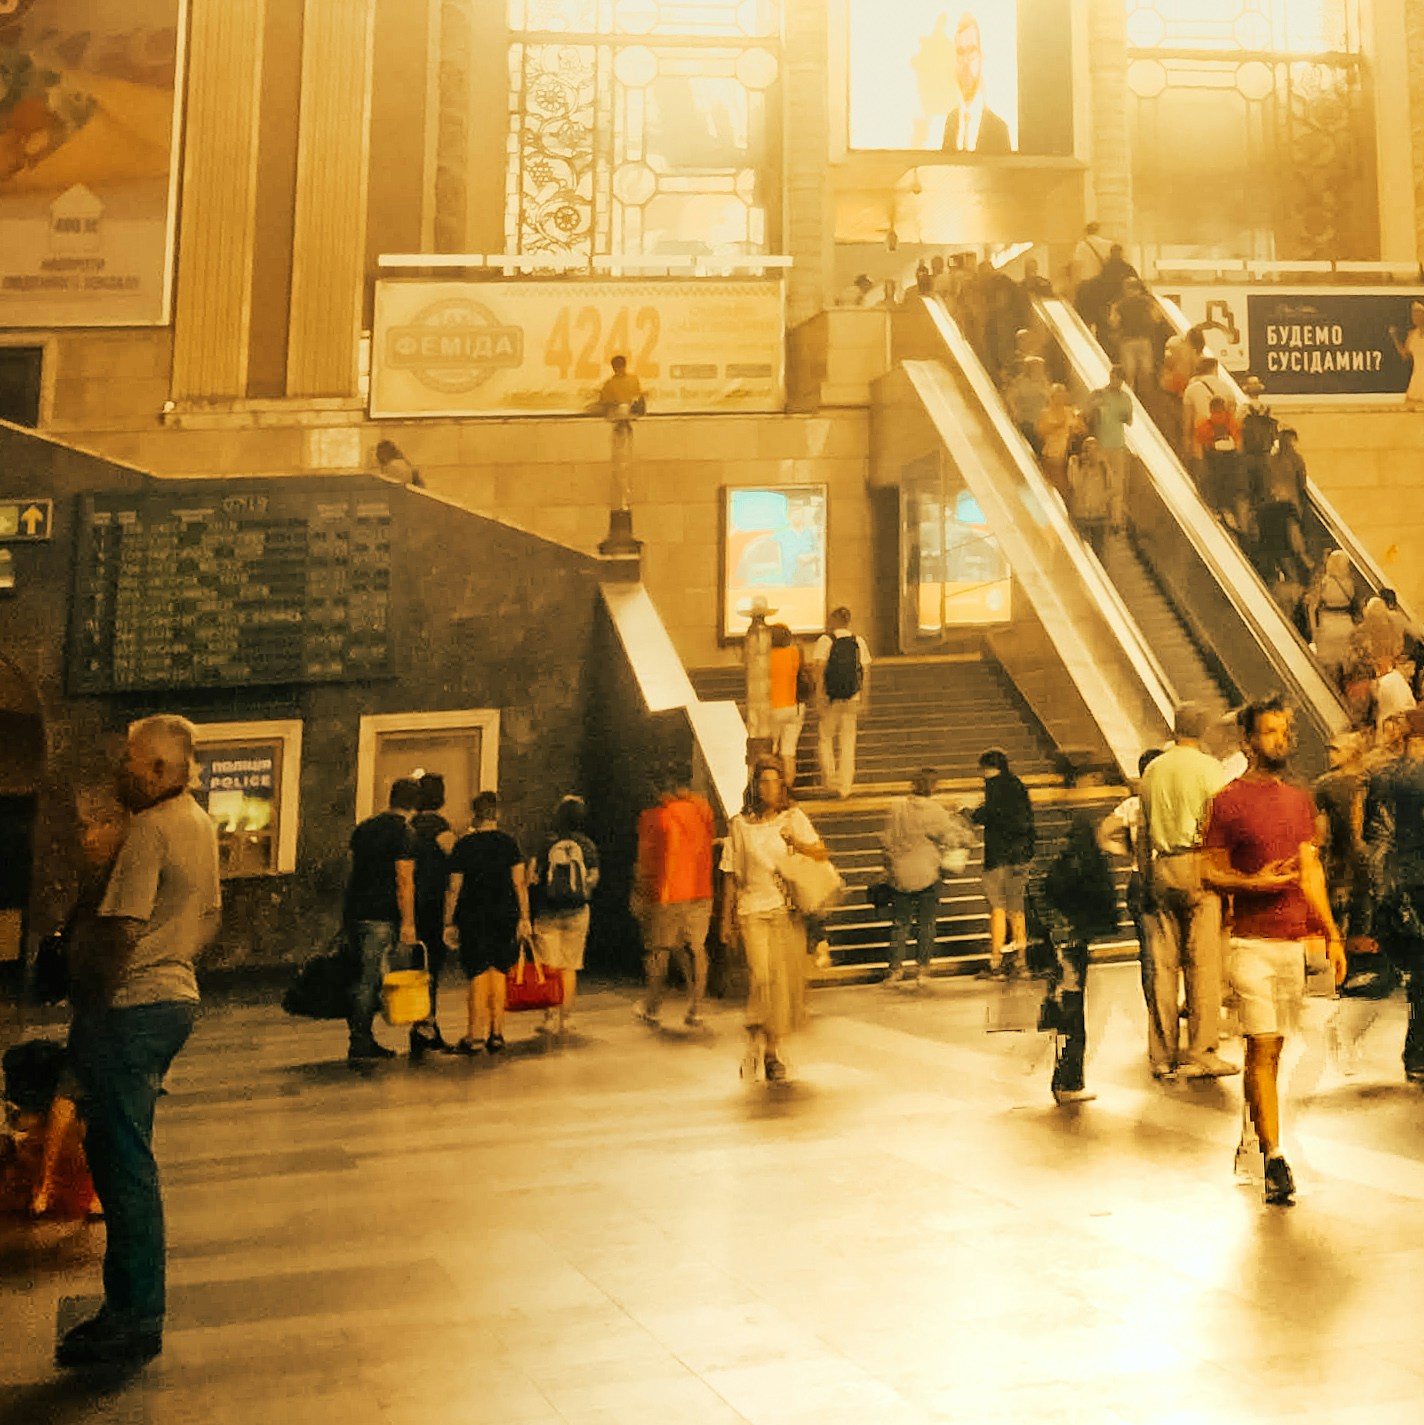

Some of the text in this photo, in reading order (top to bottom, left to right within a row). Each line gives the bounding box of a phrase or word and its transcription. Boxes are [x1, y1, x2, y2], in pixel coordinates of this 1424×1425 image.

[394, 335, 513, 359] ФЕМІДА
[543, 305, 660, 380] 4242
[1266, 325, 1343, 348] БУДЕМО
[1266, 351, 1383, 374] СУСІДАМИ!?
[210, 776, 271, 788] POLICE
